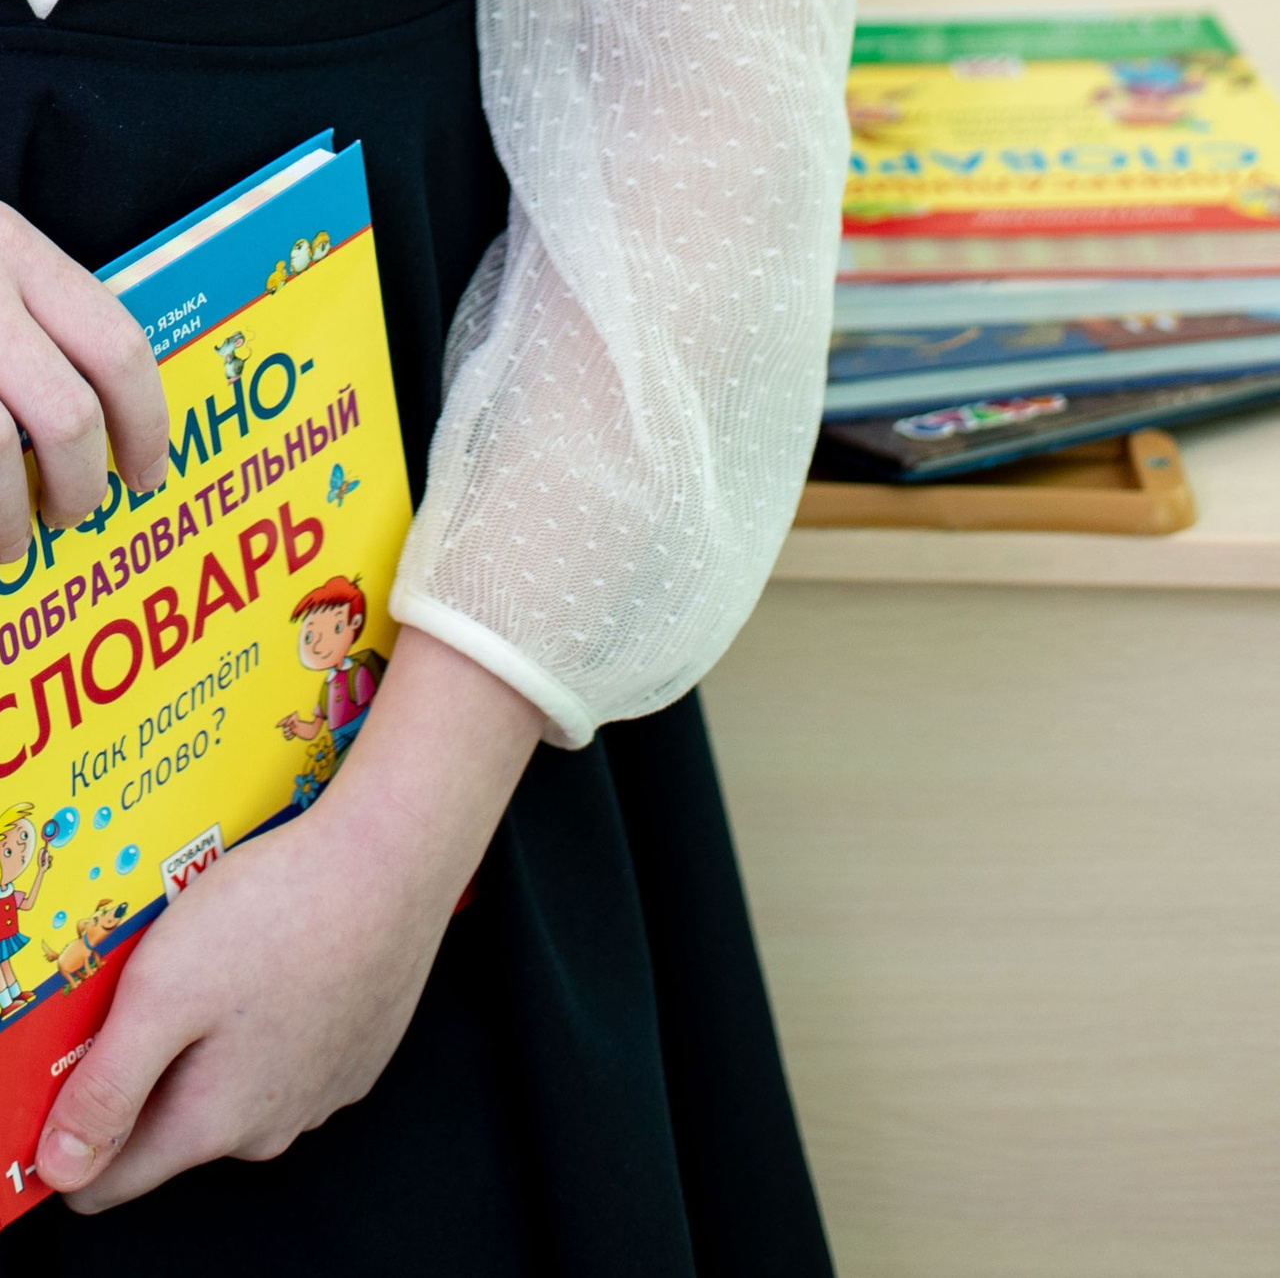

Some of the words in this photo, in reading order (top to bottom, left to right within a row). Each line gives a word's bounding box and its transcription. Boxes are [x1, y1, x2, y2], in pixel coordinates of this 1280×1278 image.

[849, 143, 1258, 176] СЛОВАР
[157, 292, 208, 332] ЯЗЫКА
[172, 315, 201, 342] РАН
[71, 735, 127, 797] Как
[138, 641, 259, 759] растёт
[121, 707, 226, 810] слово?
